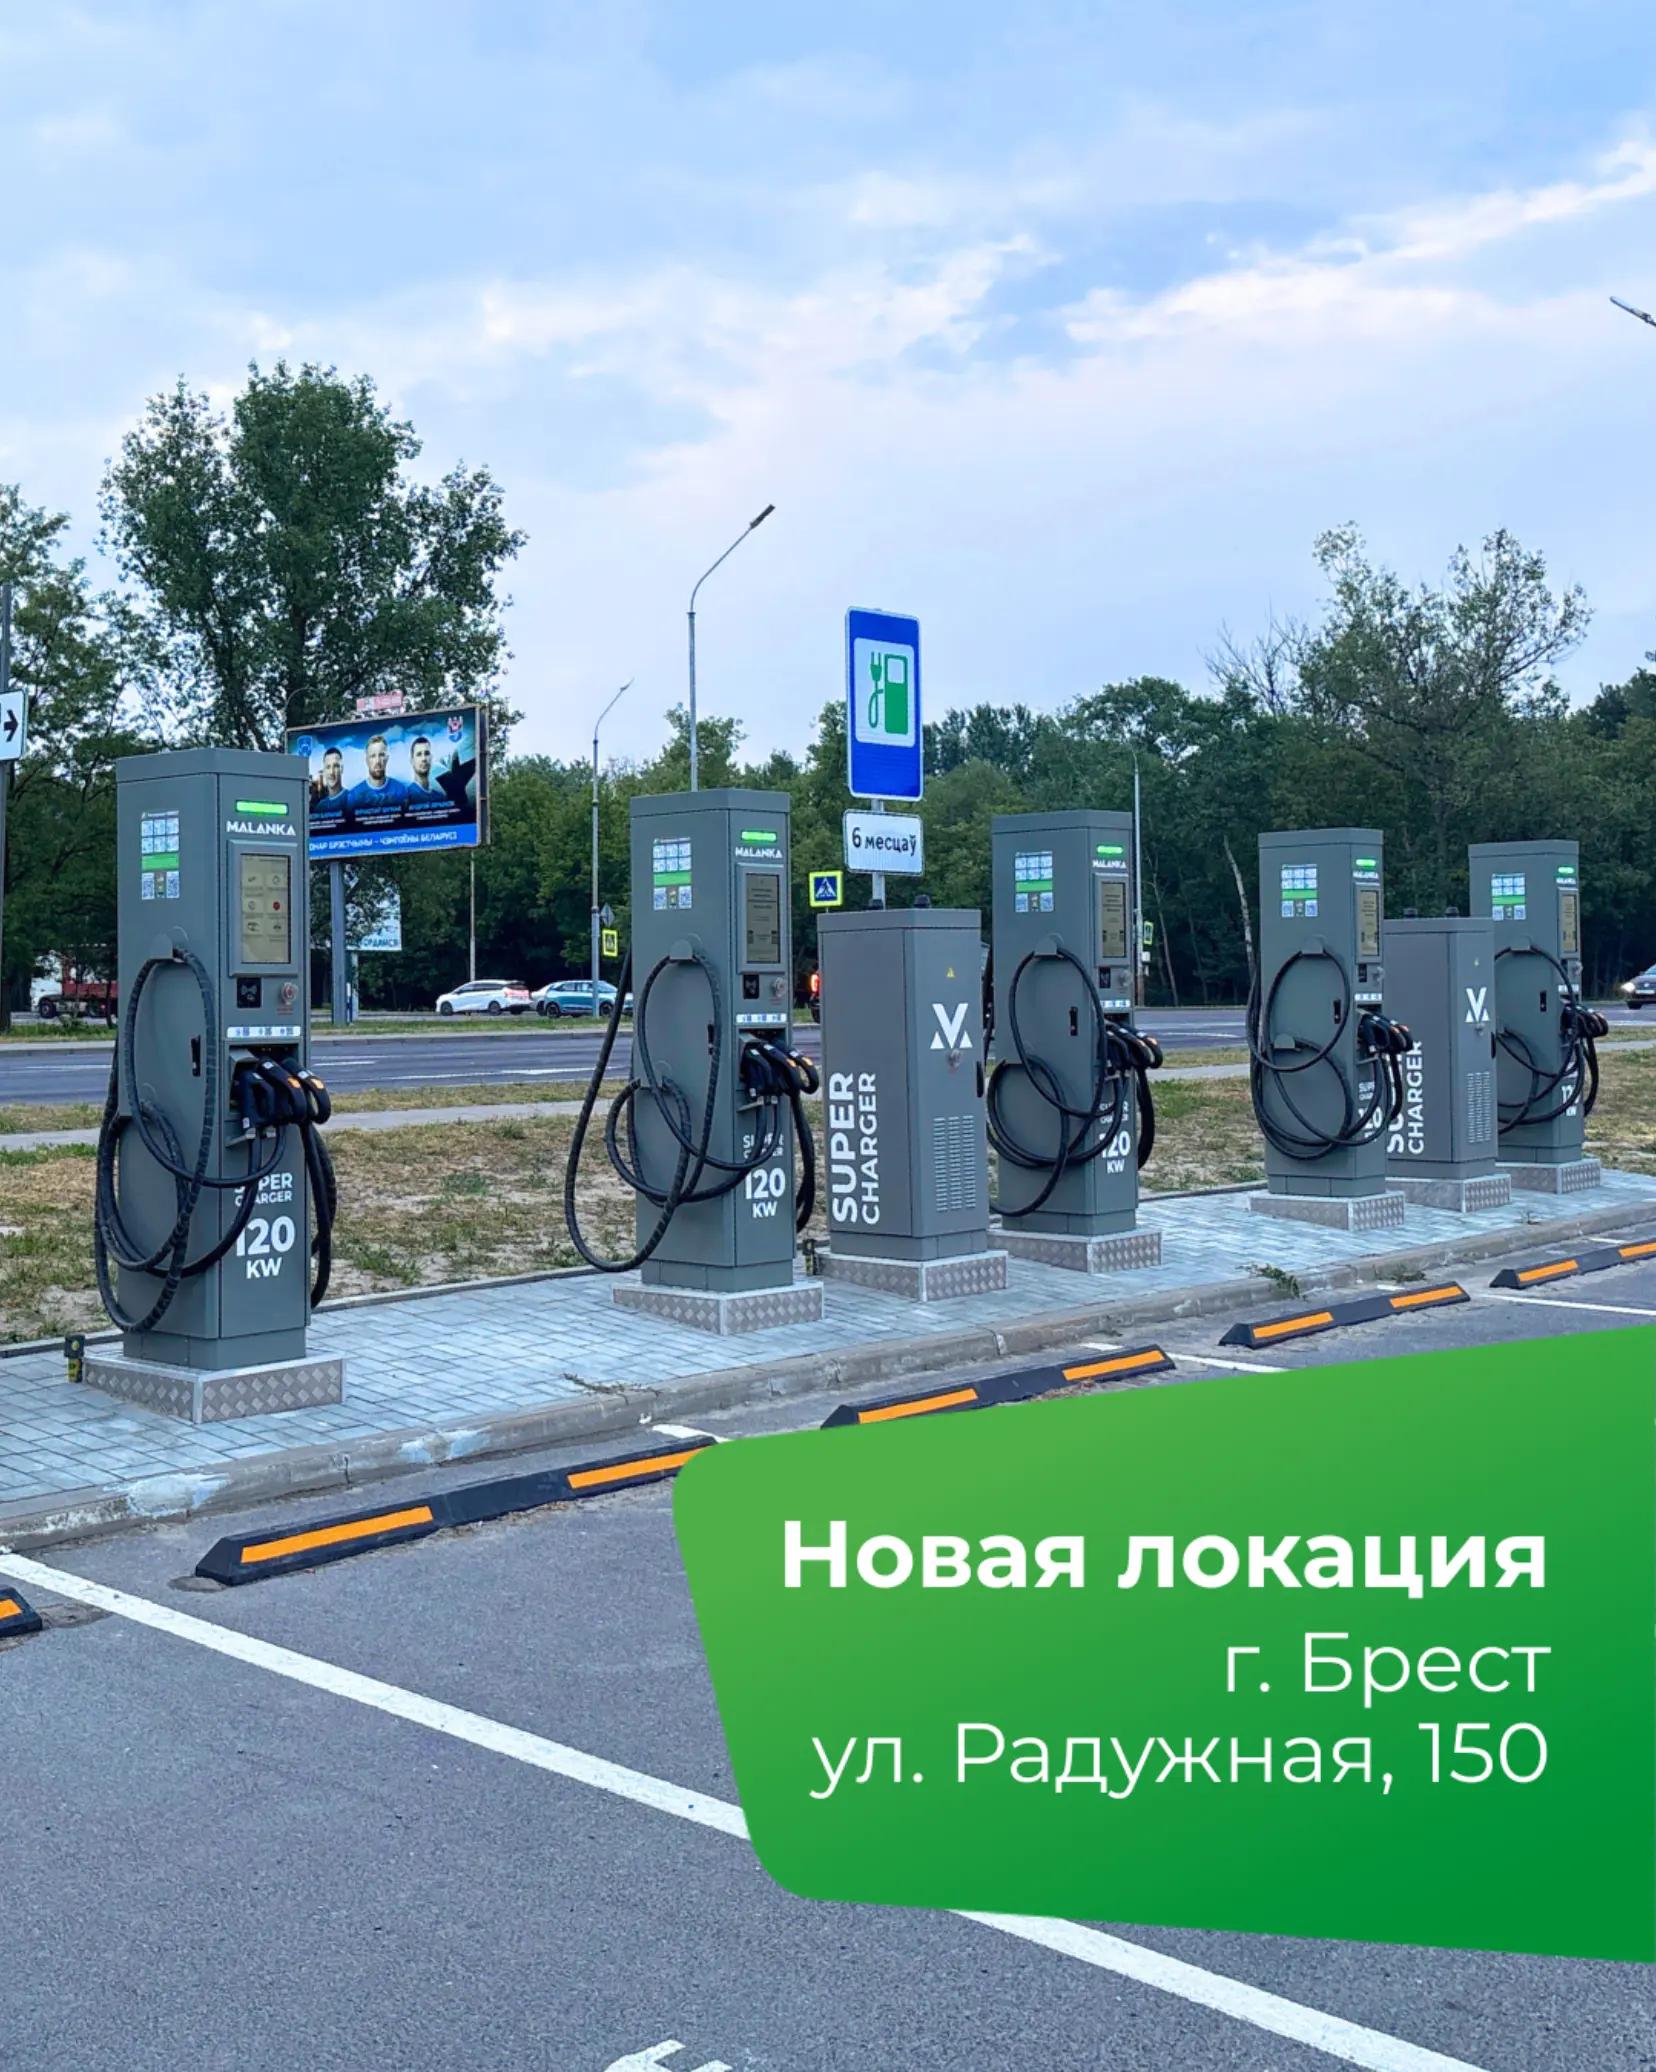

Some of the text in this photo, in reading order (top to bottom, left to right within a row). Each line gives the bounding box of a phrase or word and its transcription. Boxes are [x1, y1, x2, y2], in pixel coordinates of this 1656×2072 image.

[226, 820, 296, 836] MALANKA
[735, 847, 783, 858] MALANKA
[852, 826, 917, 857] 6 месцаў
[1406, 1040, 1424, 1154] CHARGER
[829, 1072, 858, 1223] SUPER
[858, 1073, 880, 1225] CHARGER
[1107, 1159, 1125, 1174] KW
[234, 1172, 293, 1193] PER
[745, 1167, 786, 1199] 120
[235, 1190, 293, 1207] CARGER
[752, 1201, 778, 1218] KW
[236, 1216, 295, 1257] 120
[246, 1257, 282, 1279] KW
